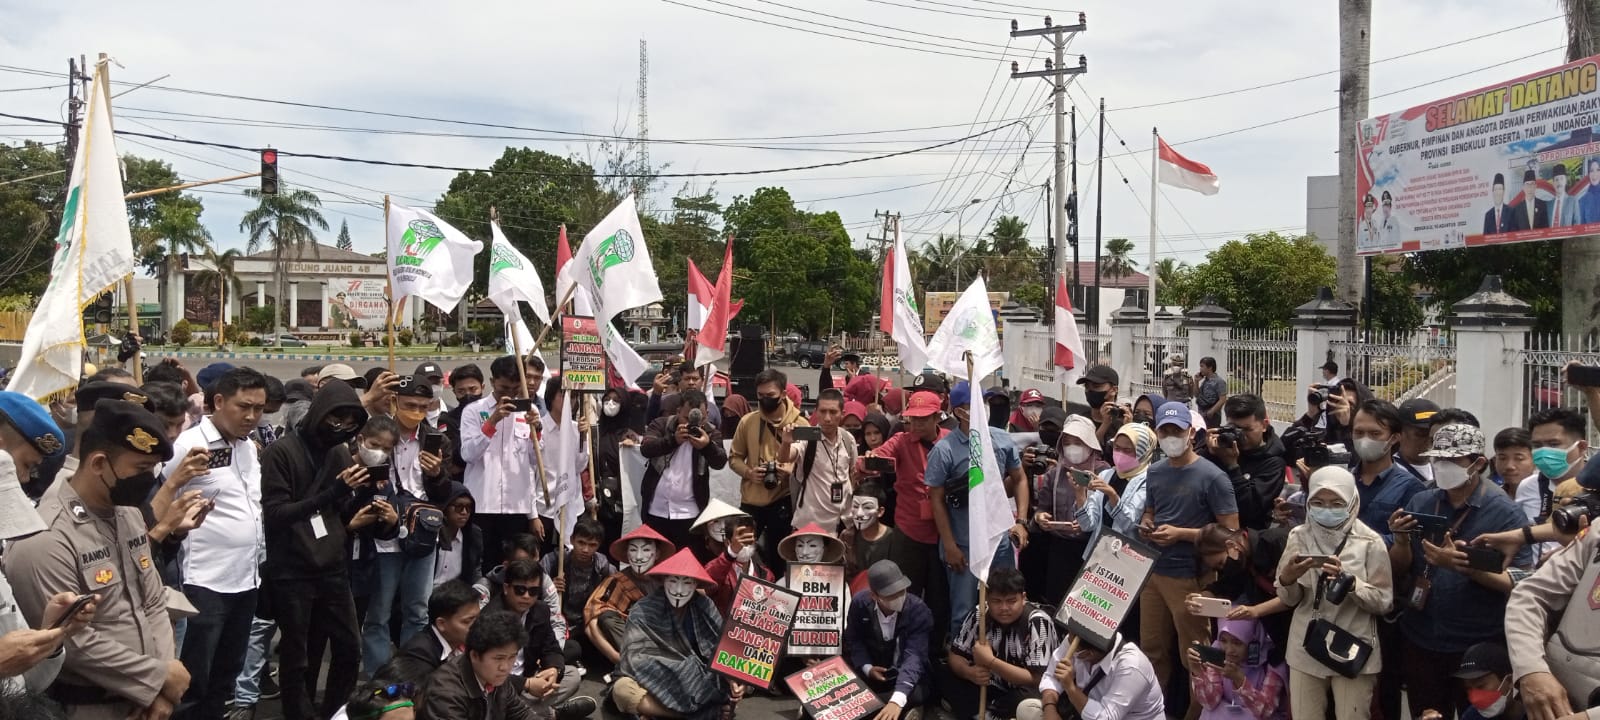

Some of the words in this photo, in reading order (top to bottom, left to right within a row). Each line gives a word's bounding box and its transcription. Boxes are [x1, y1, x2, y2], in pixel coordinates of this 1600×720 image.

[1425, 87, 1508, 133] SELAMAT
[1509, 63, 1597, 112] DATANG
[1389, 141, 1420, 155] GUBERNUR,
[1421, 133, 1450, 149] PIMPINAN
[1451, 131, 1464, 142] DAN
[1465, 124, 1498, 141] ANGGOTA
[1499, 117, 1525, 132] DEWAN
[1526, 102, 1578, 126] PERWAKILAN
[1420, 146, 1448, 161] PROVINSI
[1450, 140, 1486, 155] BENGKULU
[1489, 133, 1521, 148] BESERTA
[1524, 124, 1546, 138] TAMU
[1552, 113, 1599, 133] UNDANGAN
[323, 264, 352, 273] JUANG
[567, 343, 603, 354] JANGAN
[568, 374, 601, 383] RAKYAT
[82, 547, 110, 564] RANDU
[1083, 571, 1129, 601] BERGOYANG
[1096, 566, 1125, 587] ISTANA
[803, 582, 830, 594] BBM
[742, 599, 767, 612] HISAP
[769, 608, 792, 622] UANG
[799, 596, 833, 611] NAIK
[1081, 590, 1114, 611] RAKYAT
[733, 608, 788, 637] PEJABAT
[795, 616, 837, 625] PRESIDEN
[1066, 596, 1118, 630] BERGUNCANG
[728, 627, 781, 655] JANGAN
[792, 630, 838, 645] TURUN
[717, 651, 772, 680] RAKYAT
[744, 646, 774, 665] UANG
